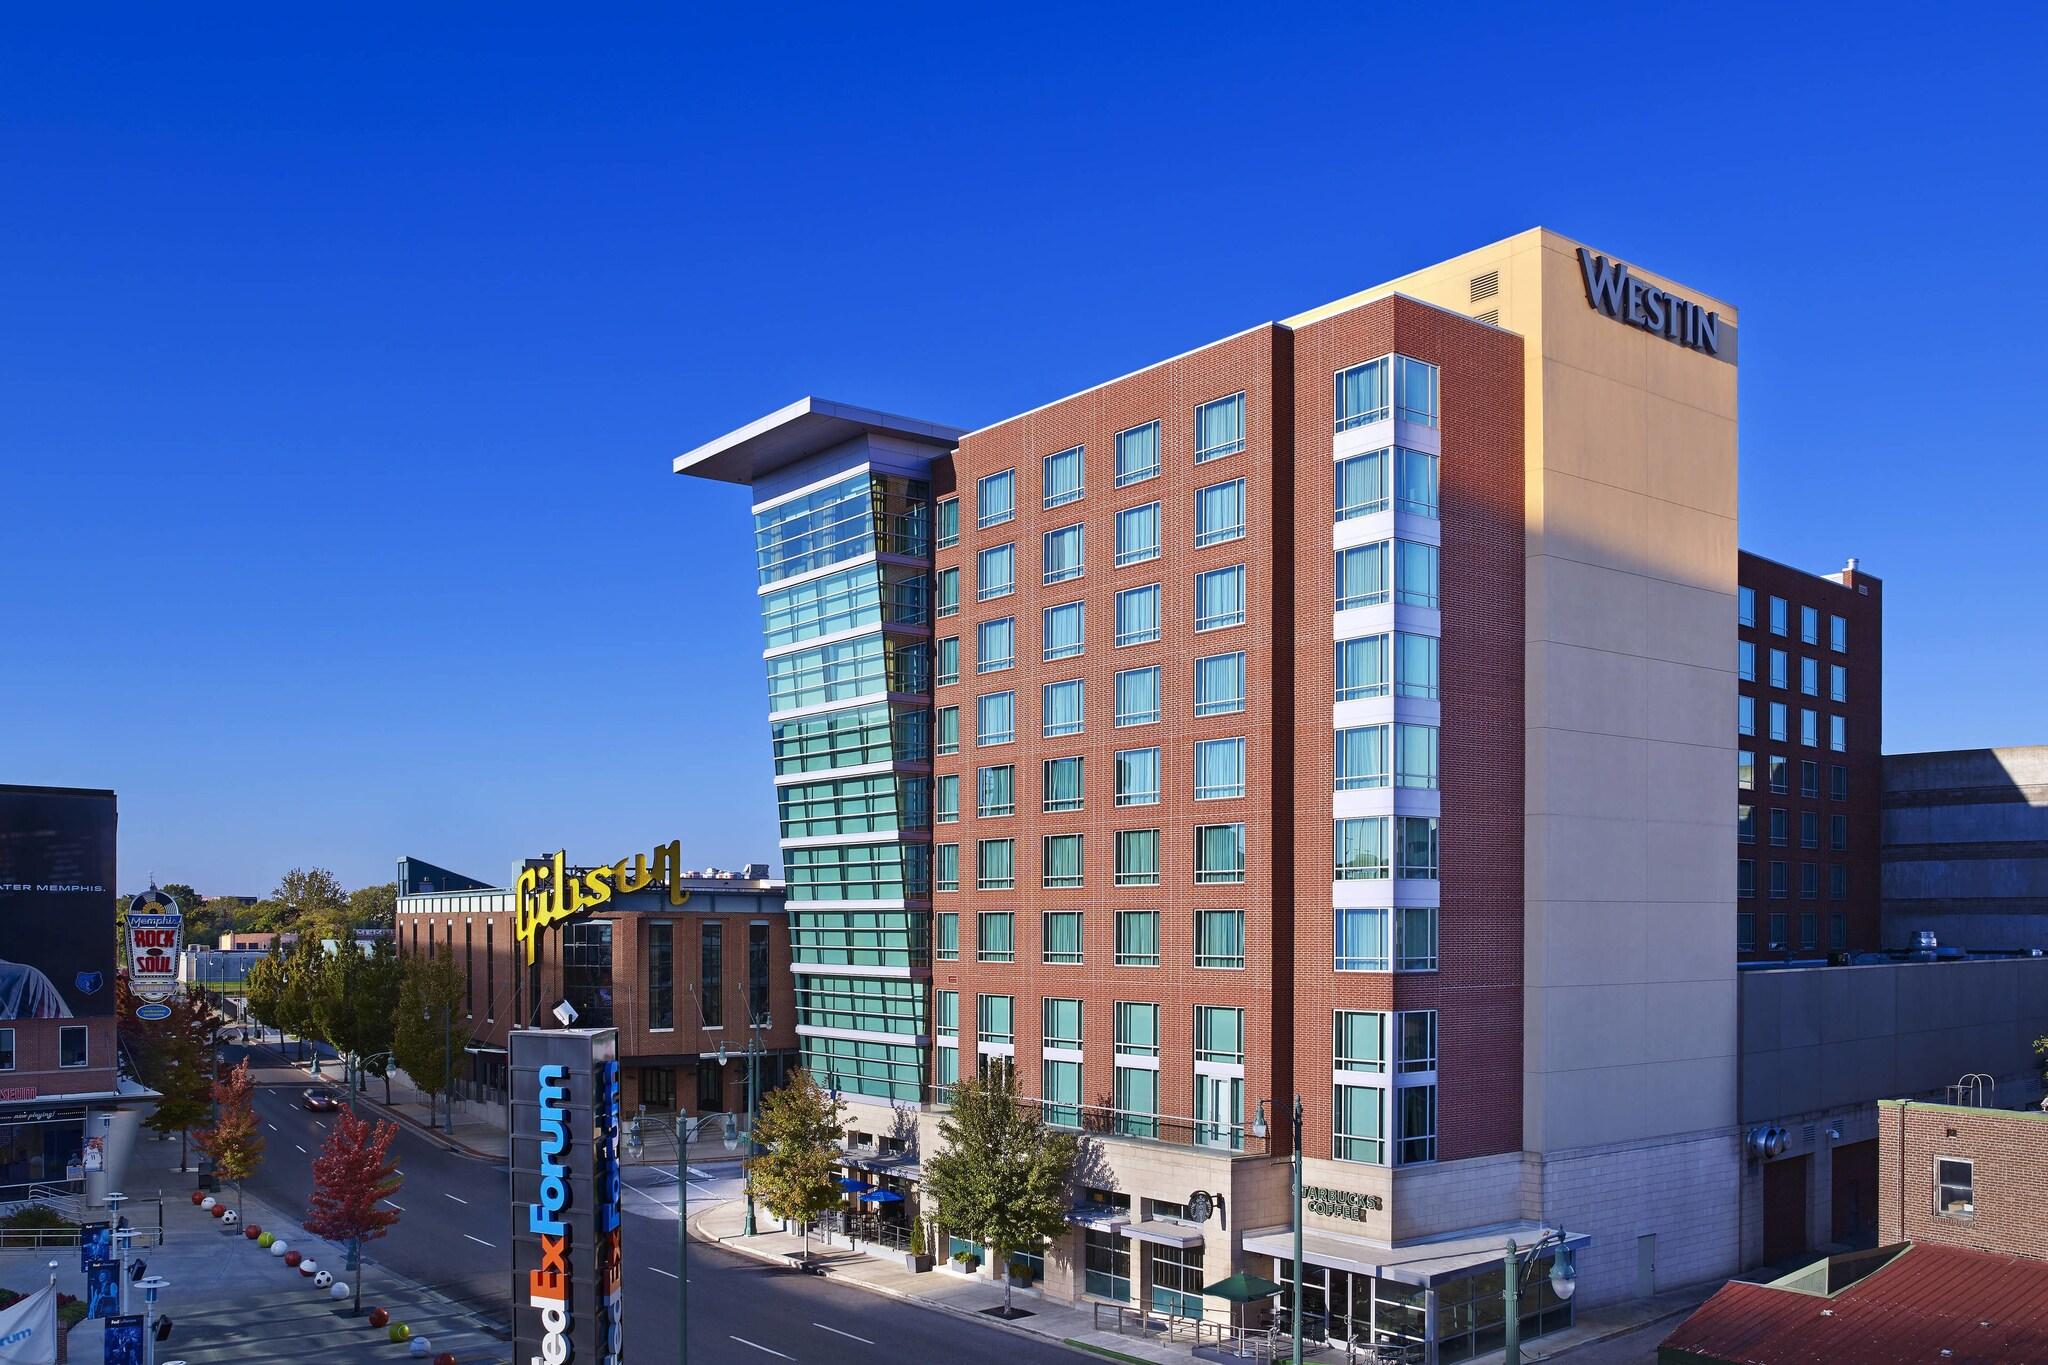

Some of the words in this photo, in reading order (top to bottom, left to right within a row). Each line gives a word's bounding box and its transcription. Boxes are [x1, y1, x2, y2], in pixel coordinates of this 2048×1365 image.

[1575, 247, 1720, 354] WESTIN
[36, 884, 106, 892] MEMPHIS.
[516, 839, 690, 966] Gibson
[131, 916, 178, 929] Memphis
[134, 930, 175, 948] ROCK
[136, 956, 172, 973] SOUL
[1308, 1200, 1360, 1221] COFFEE
